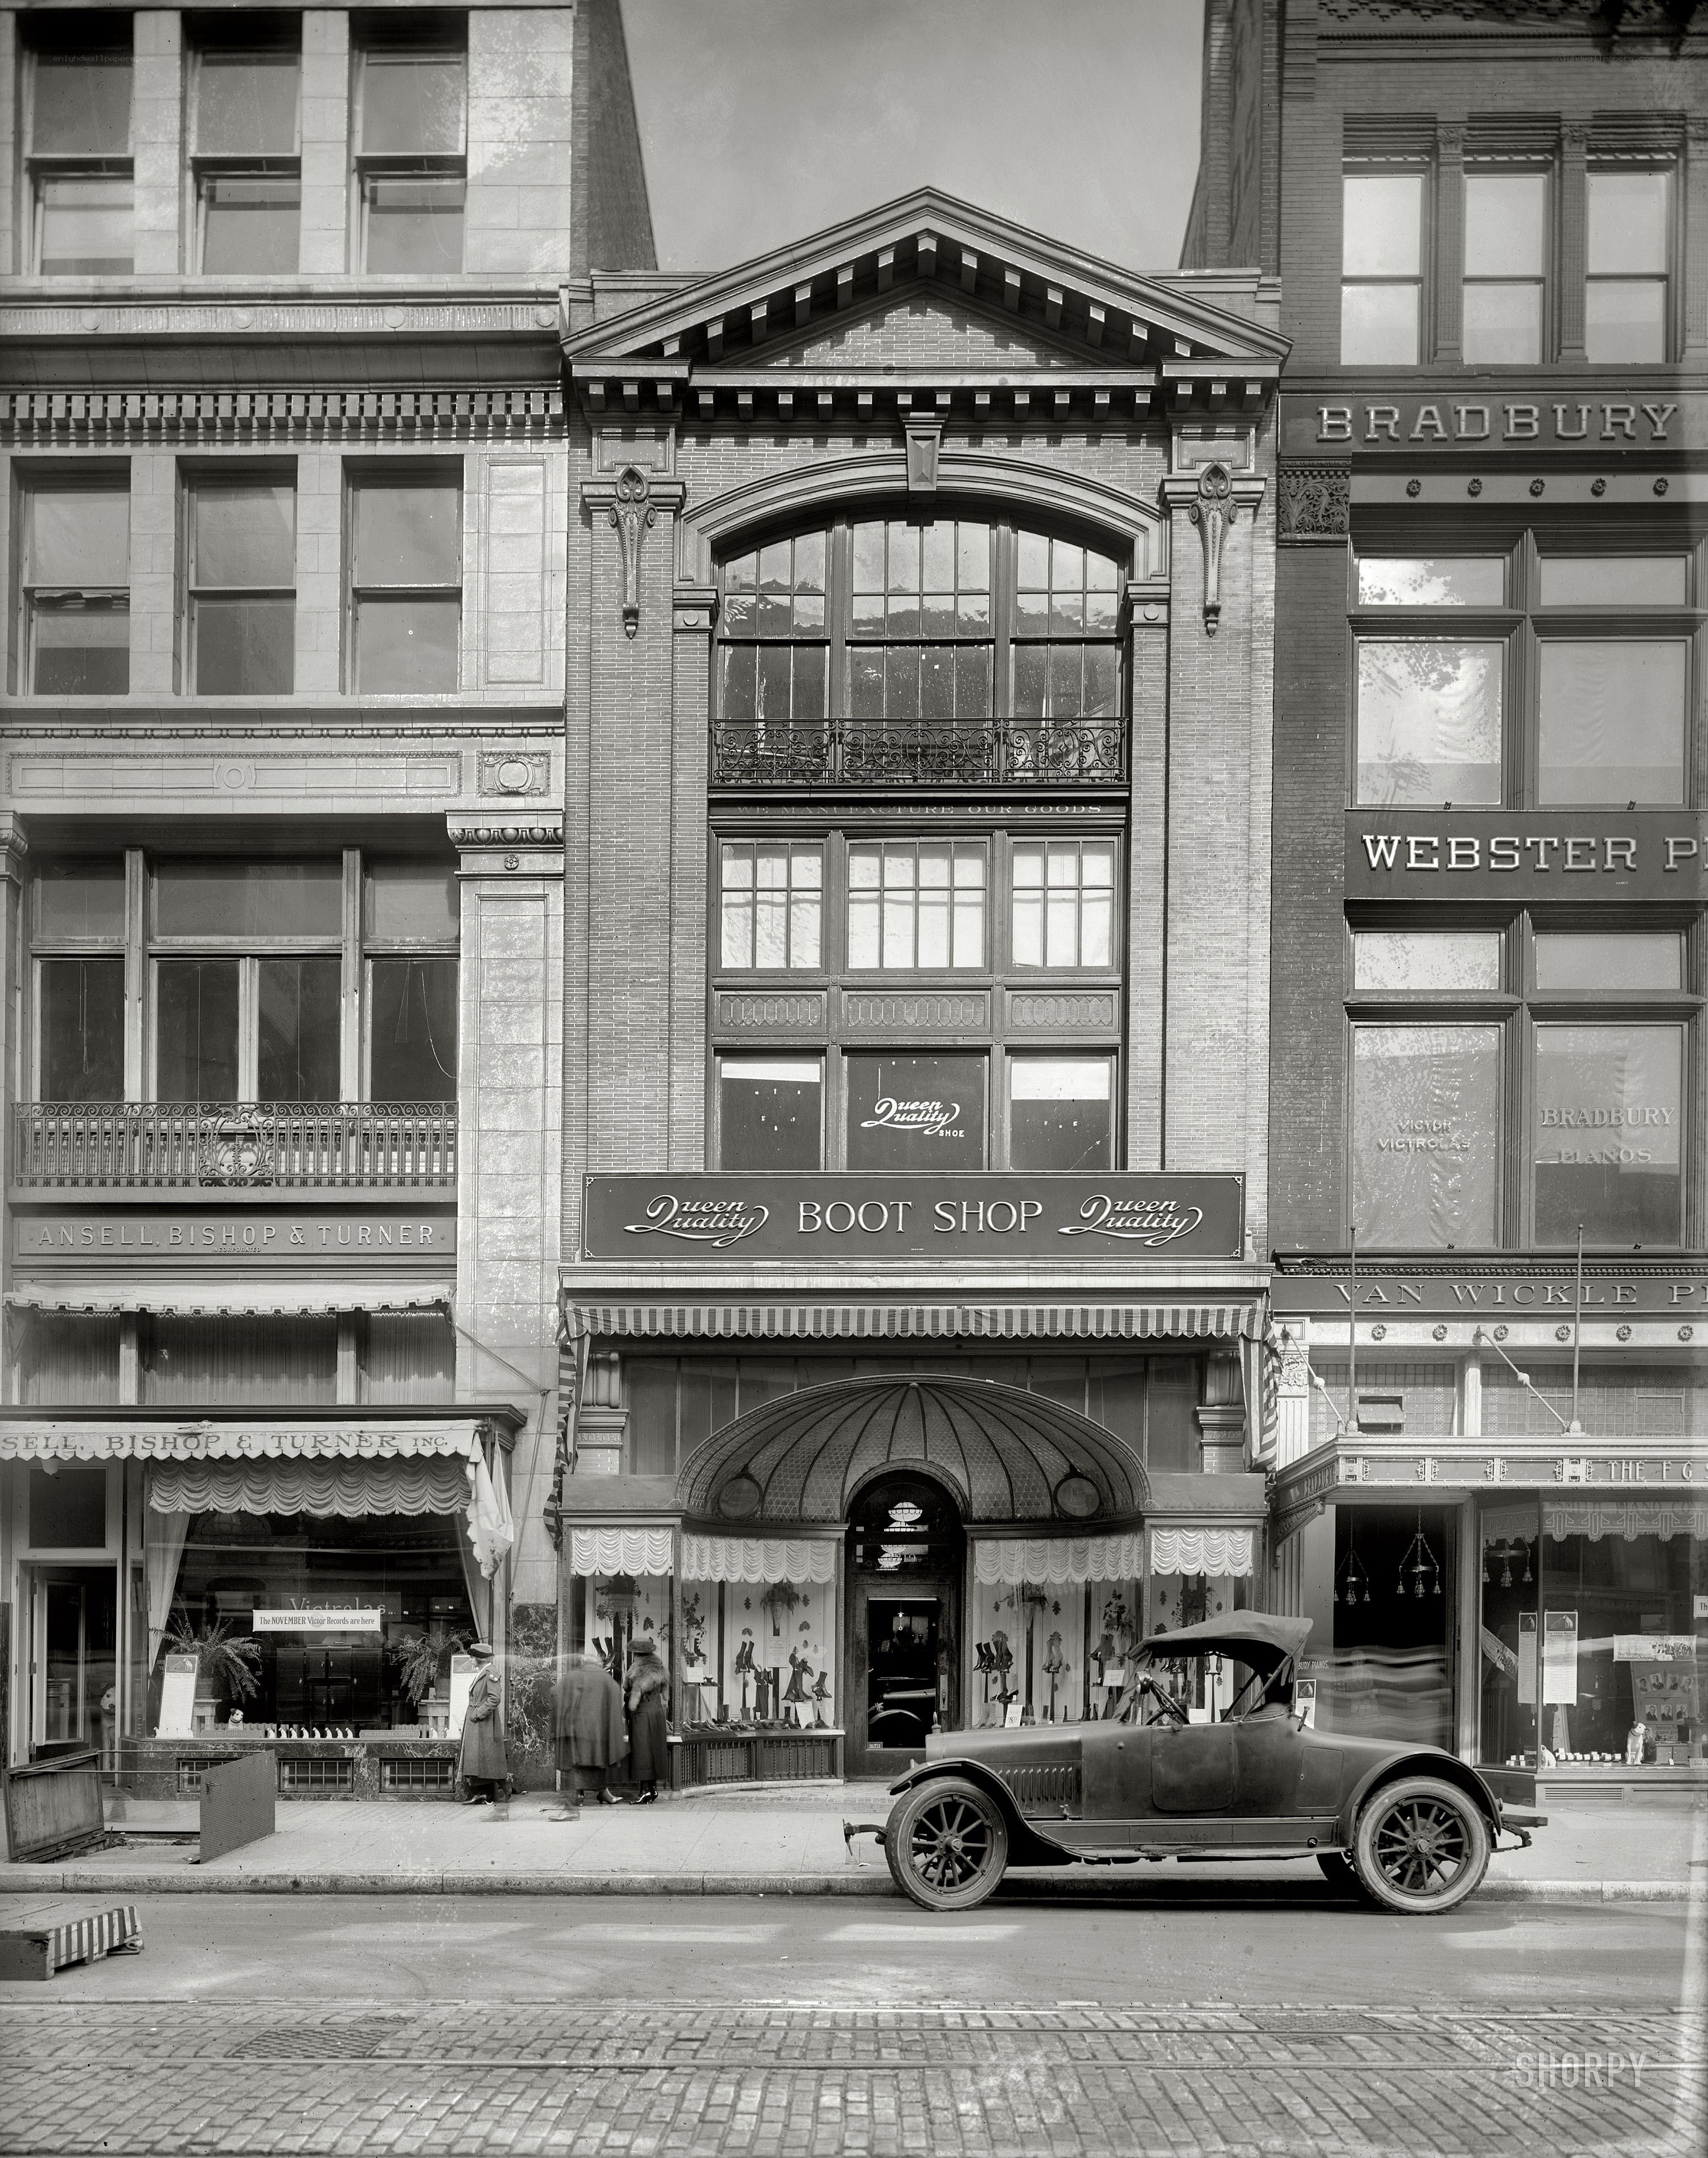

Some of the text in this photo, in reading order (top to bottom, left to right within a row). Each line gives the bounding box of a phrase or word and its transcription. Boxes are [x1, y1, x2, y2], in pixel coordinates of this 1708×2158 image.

[1316, 404, 1678, 442] BRADBURY
[738, 805, 1102, 814] WE MANUFACTURE OUR GOODS
[1361, 835, 1637, 872] WEBSTER
[1397, 1119, 1452, 1131] VICTOR
[1542, 1106, 1677, 1126] BRADBURY
[1378, 1138, 1471, 1150] VICTROLAS
[797, 1201, 1043, 1233] BOOT SHOP
[38, 1225, 433, 1246] ANSELL, BISHOP & TURNER
[1333, 1283, 1425, 1304] VAN
[1450, 1283, 1637, 1304] WICKLE
[106, 1435, 221, 1451] BISHOP
[236, 1435, 253, 1451] &
[271, 1434, 399, 1449] TURNER
[412, 1436, 448, 1447] INC.
[1607, 1461, 1645, 1480] THE
